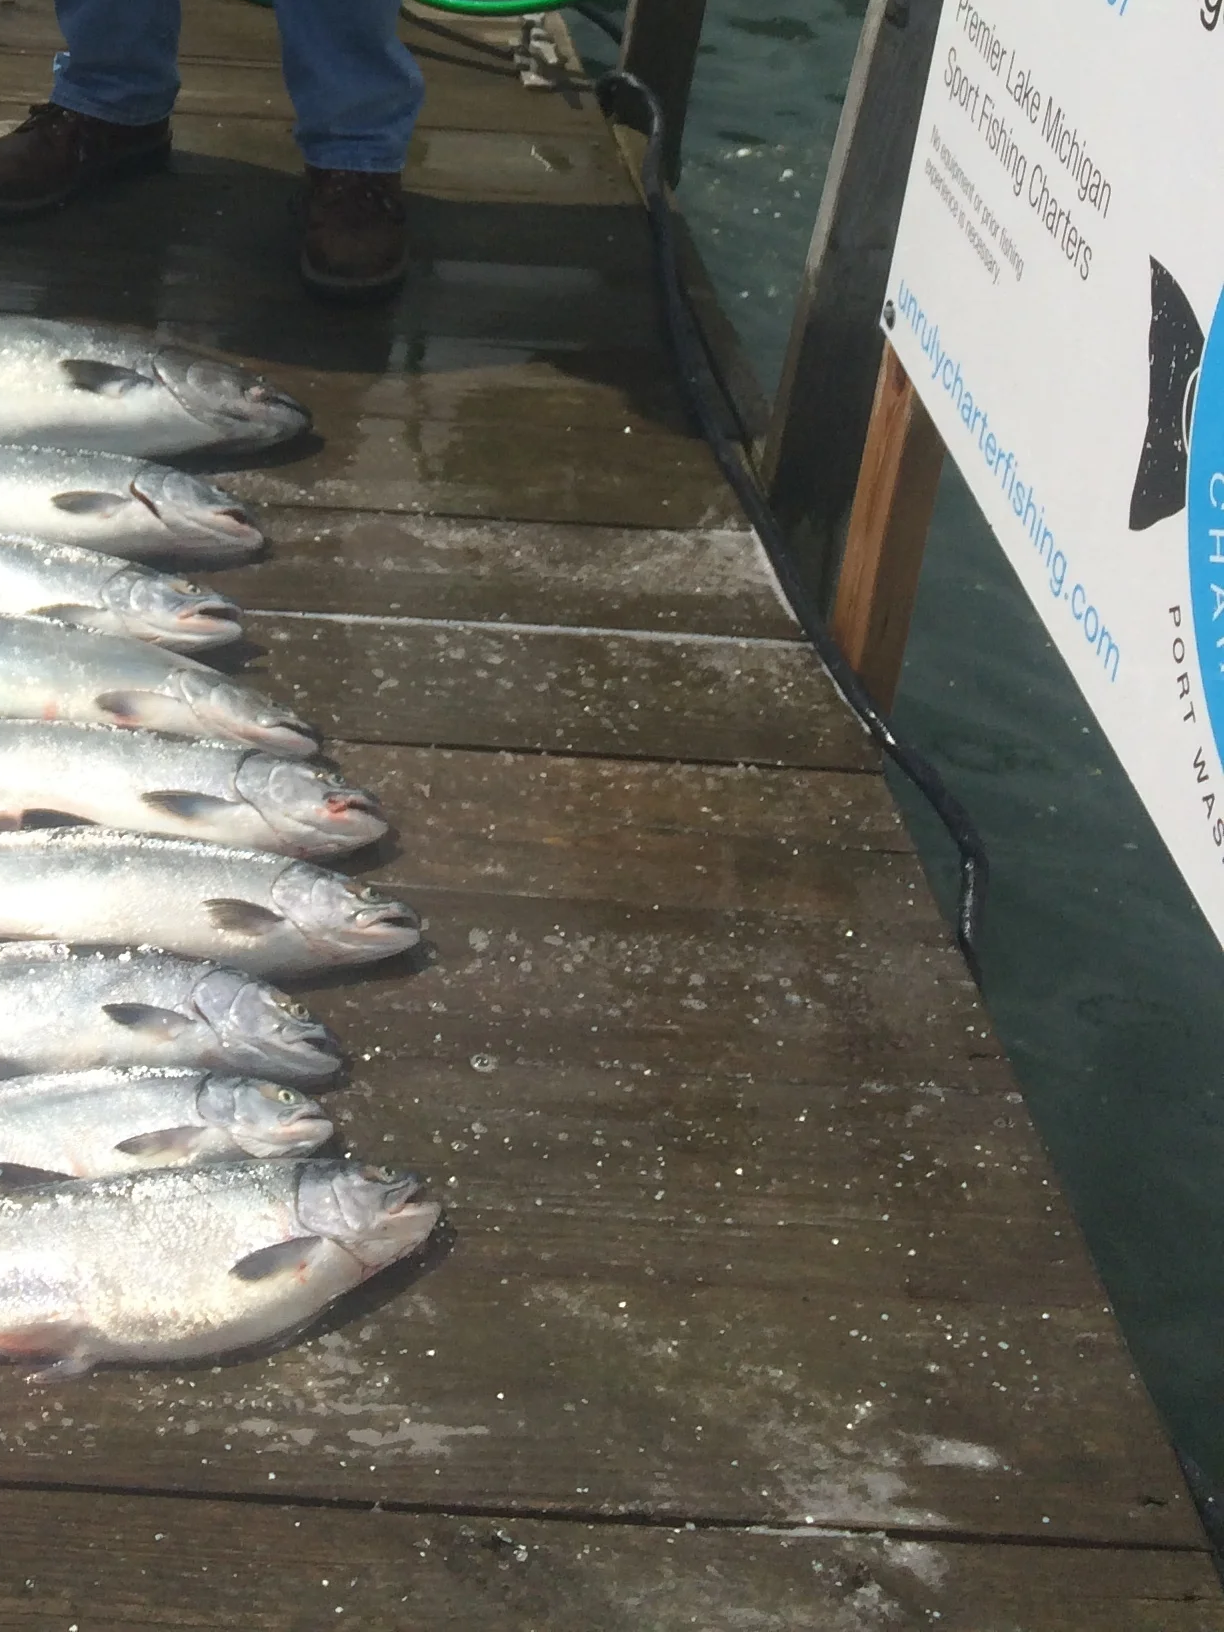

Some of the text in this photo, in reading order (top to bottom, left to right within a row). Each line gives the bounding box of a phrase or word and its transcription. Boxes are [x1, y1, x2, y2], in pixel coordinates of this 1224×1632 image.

[925, 158, 959, 218] experience
[930, 124, 1025, 282] No equipment or prior fishing
[944, 47, 1093, 281] Sport Fishing Charters
[1005, 49, 1041, 124] Lake
[1041, 96, 1112, 219] Michigan
[898, 279, 1120, 682] unrulycharterfishing.com
[1168, 605, 1224, 864] PORT WAS
